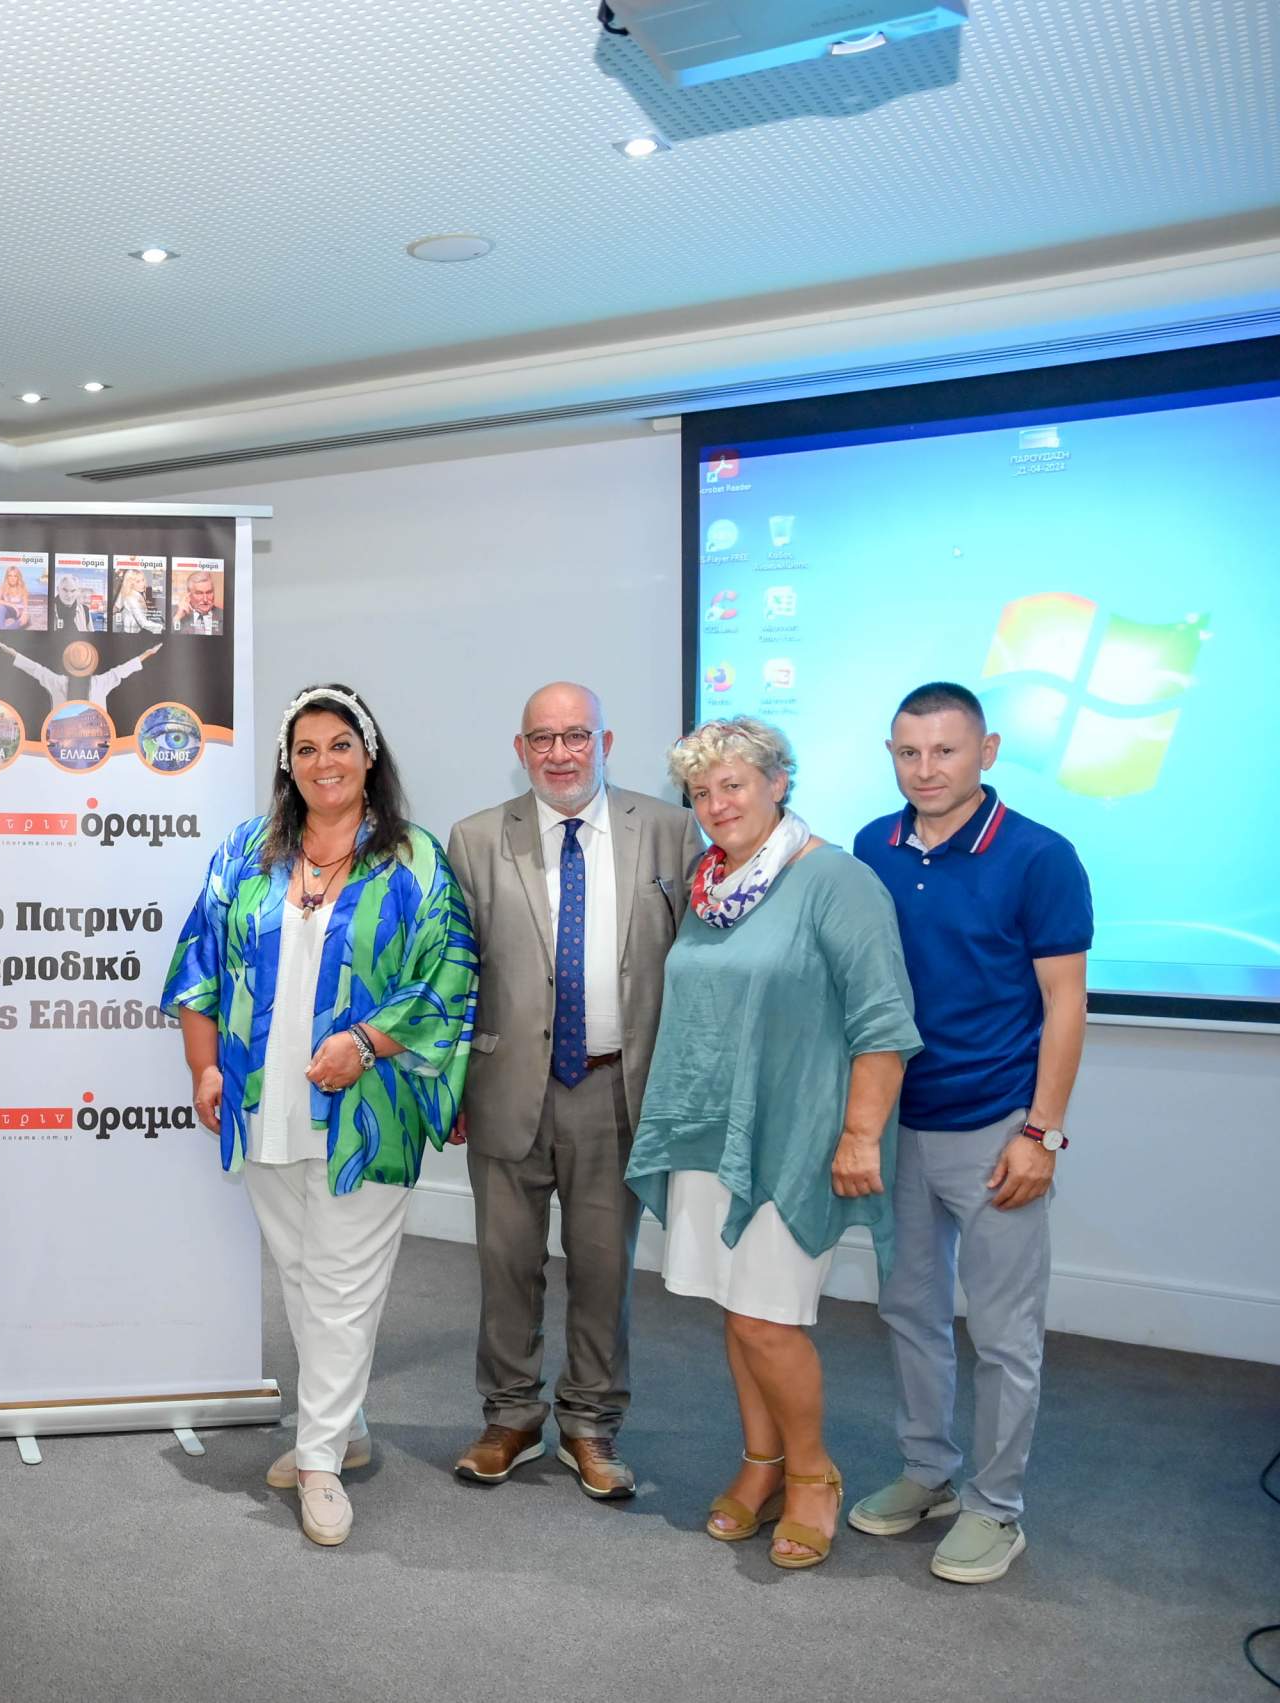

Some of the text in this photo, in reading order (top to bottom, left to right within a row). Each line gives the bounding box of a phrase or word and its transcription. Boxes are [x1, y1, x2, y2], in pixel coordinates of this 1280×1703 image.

[60, 749, 100, 761] ΕΛΛΑΔΑ
[151, 750, 191, 762] ΚΟΣΜΟΣ
[16, 901, 163, 937] Πατρινό
